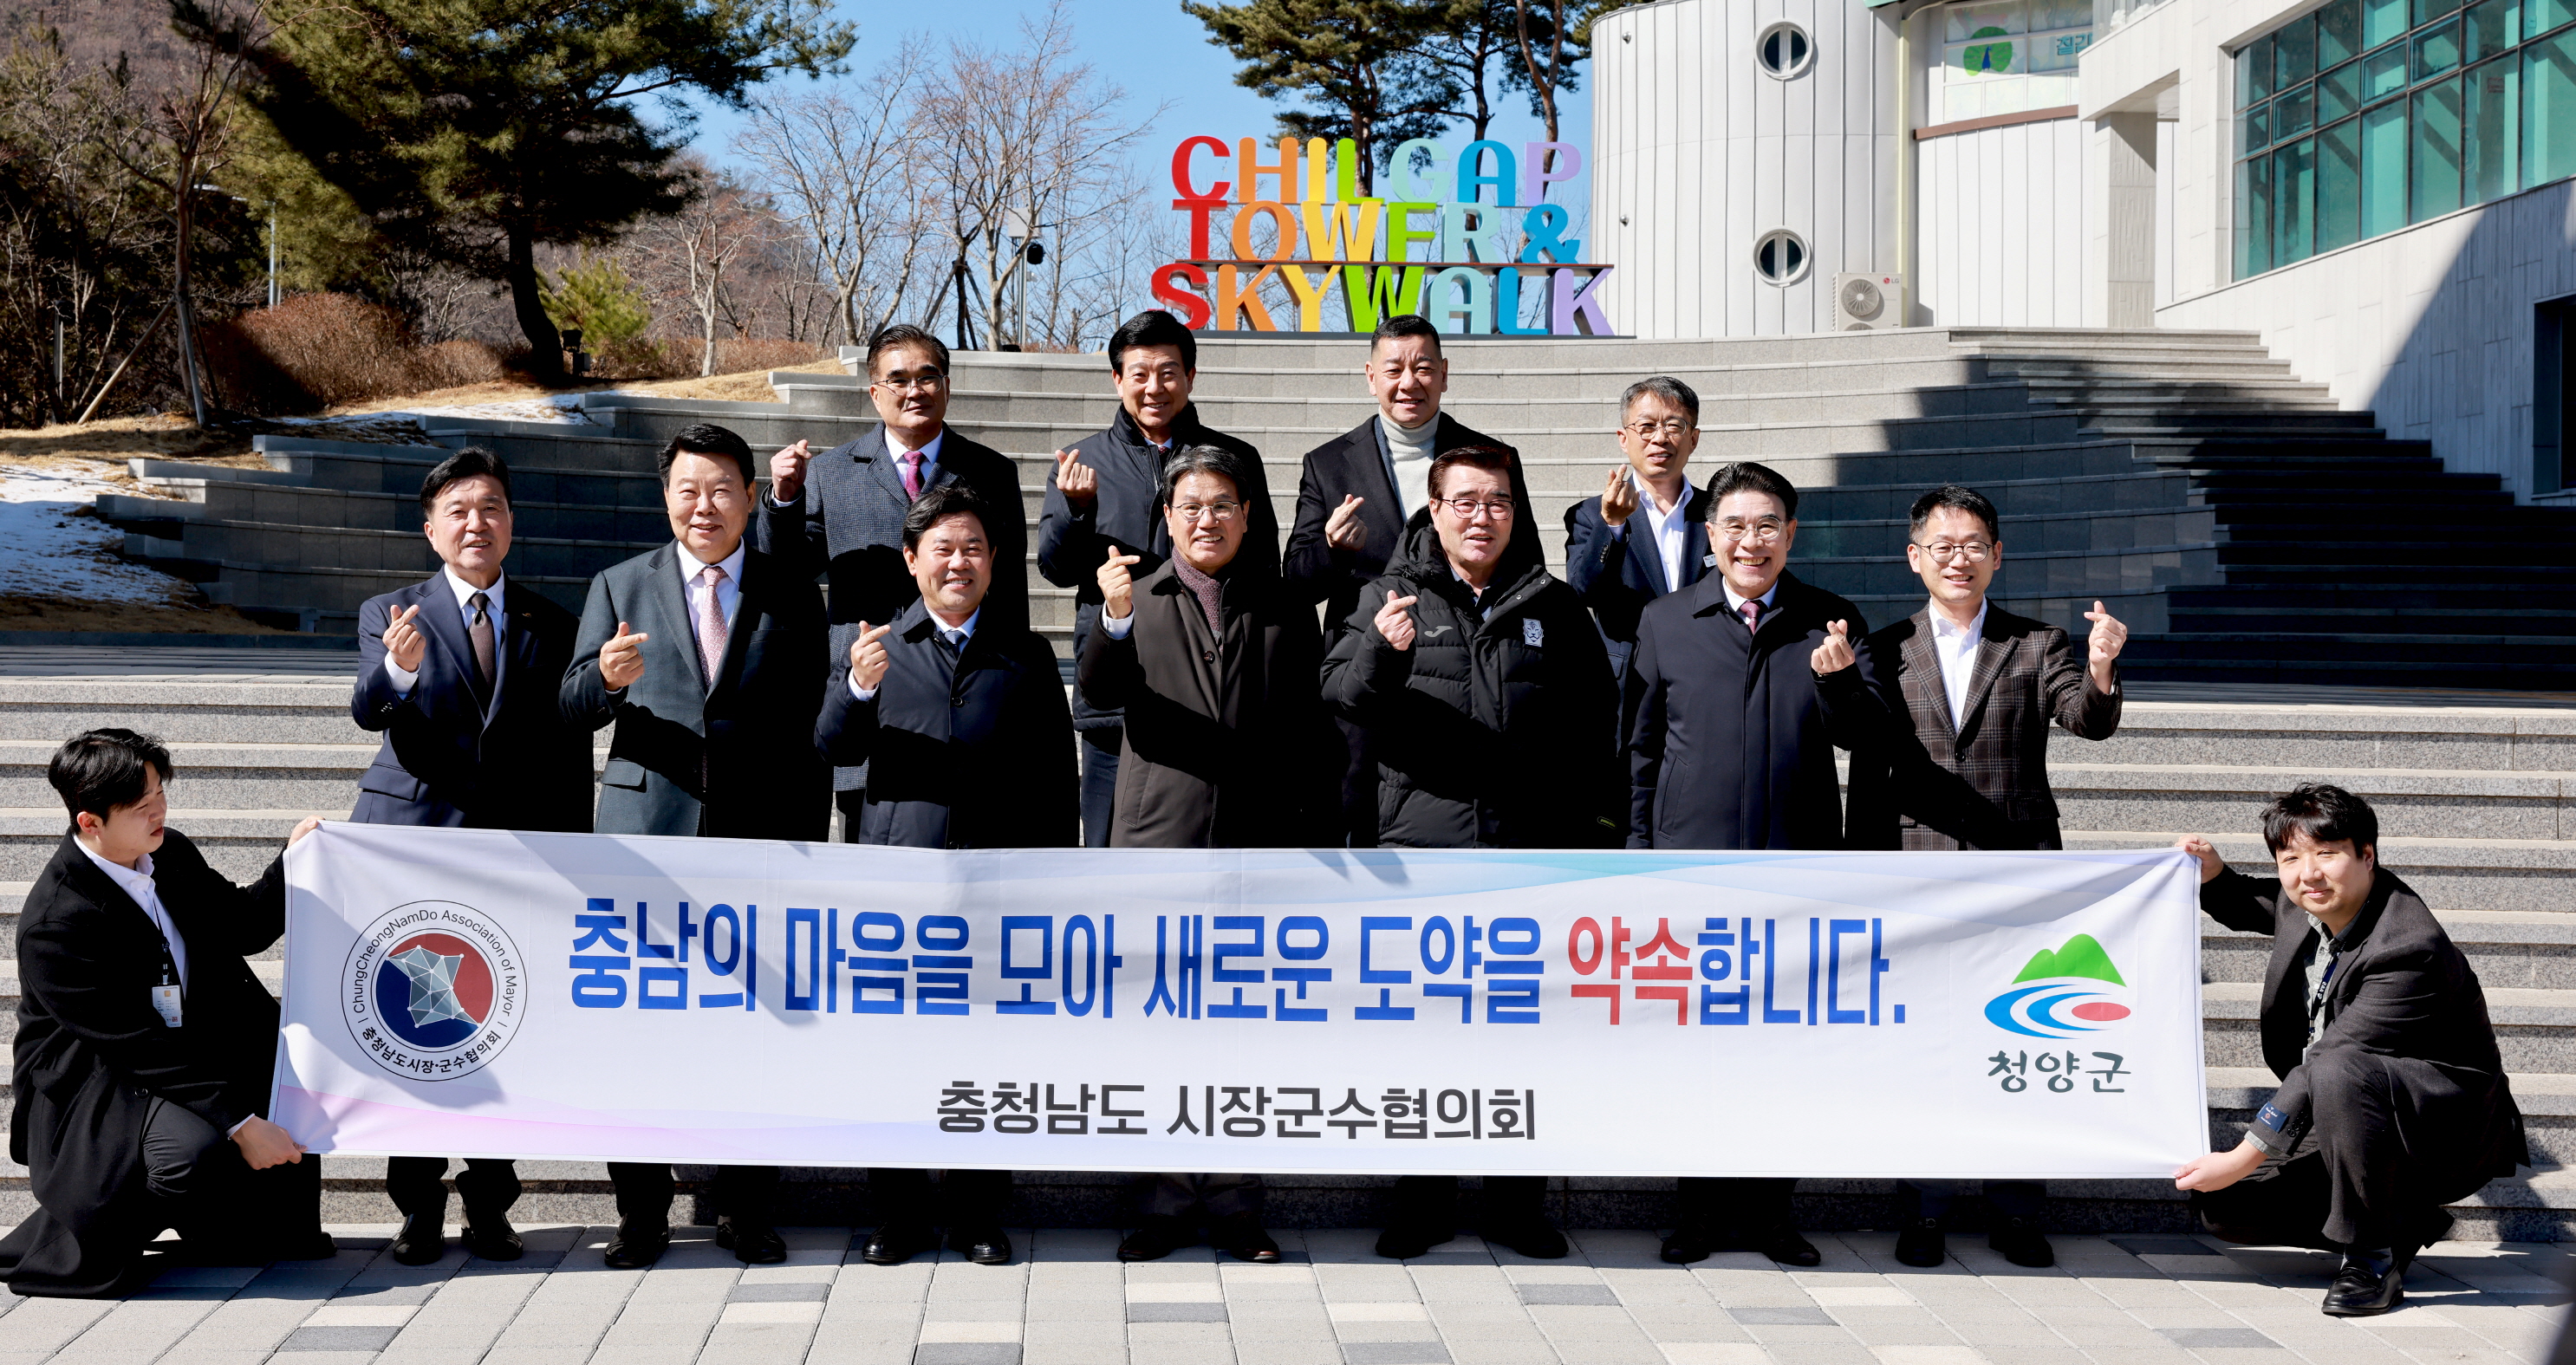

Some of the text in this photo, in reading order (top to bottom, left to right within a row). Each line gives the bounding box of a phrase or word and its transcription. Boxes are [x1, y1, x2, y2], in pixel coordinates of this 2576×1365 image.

[1171, 135, 1582, 206] CHILGAP
[1521, 204, 1581, 264] &
[1151, 263, 1615, 336] SKYWALK
[352, 909, 517, 1017] ChungCheongNamDo Association of Mayor
[569, 898, 1906, 1025] 충남의 마음을 모아 새로운 도약을 약속합니다.
[1987, 1050, 2131, 1093] 청양군
[937, 1081, 1535, 1141] 충청남도 시장군수협의회
